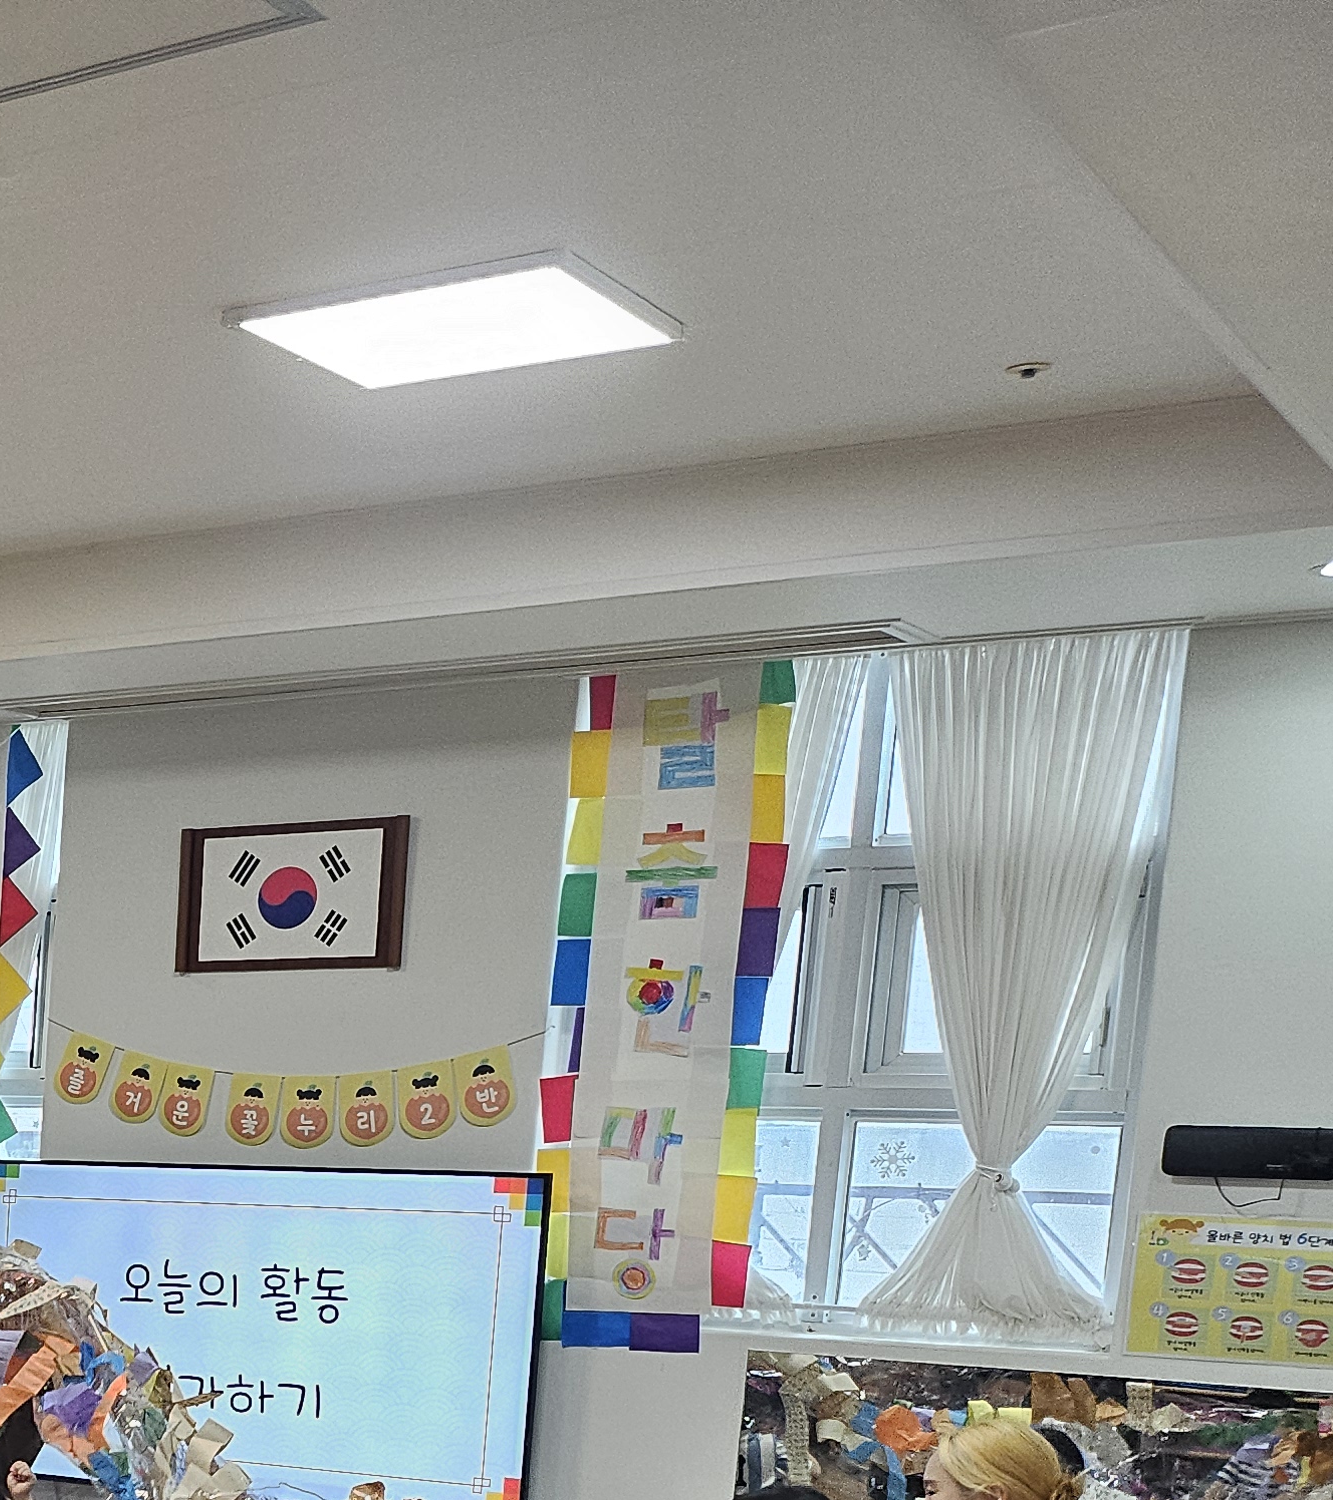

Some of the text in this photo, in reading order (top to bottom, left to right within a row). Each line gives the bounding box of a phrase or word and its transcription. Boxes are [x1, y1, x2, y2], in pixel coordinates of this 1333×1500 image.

[1207, 1230, 1244, 1244] 올바른
[1249, 1232, 1274, 1245] 양치
[1279, 1233, 1292, 1246] 법
[119, 1259, 349, 1324] 오늘의 활동
